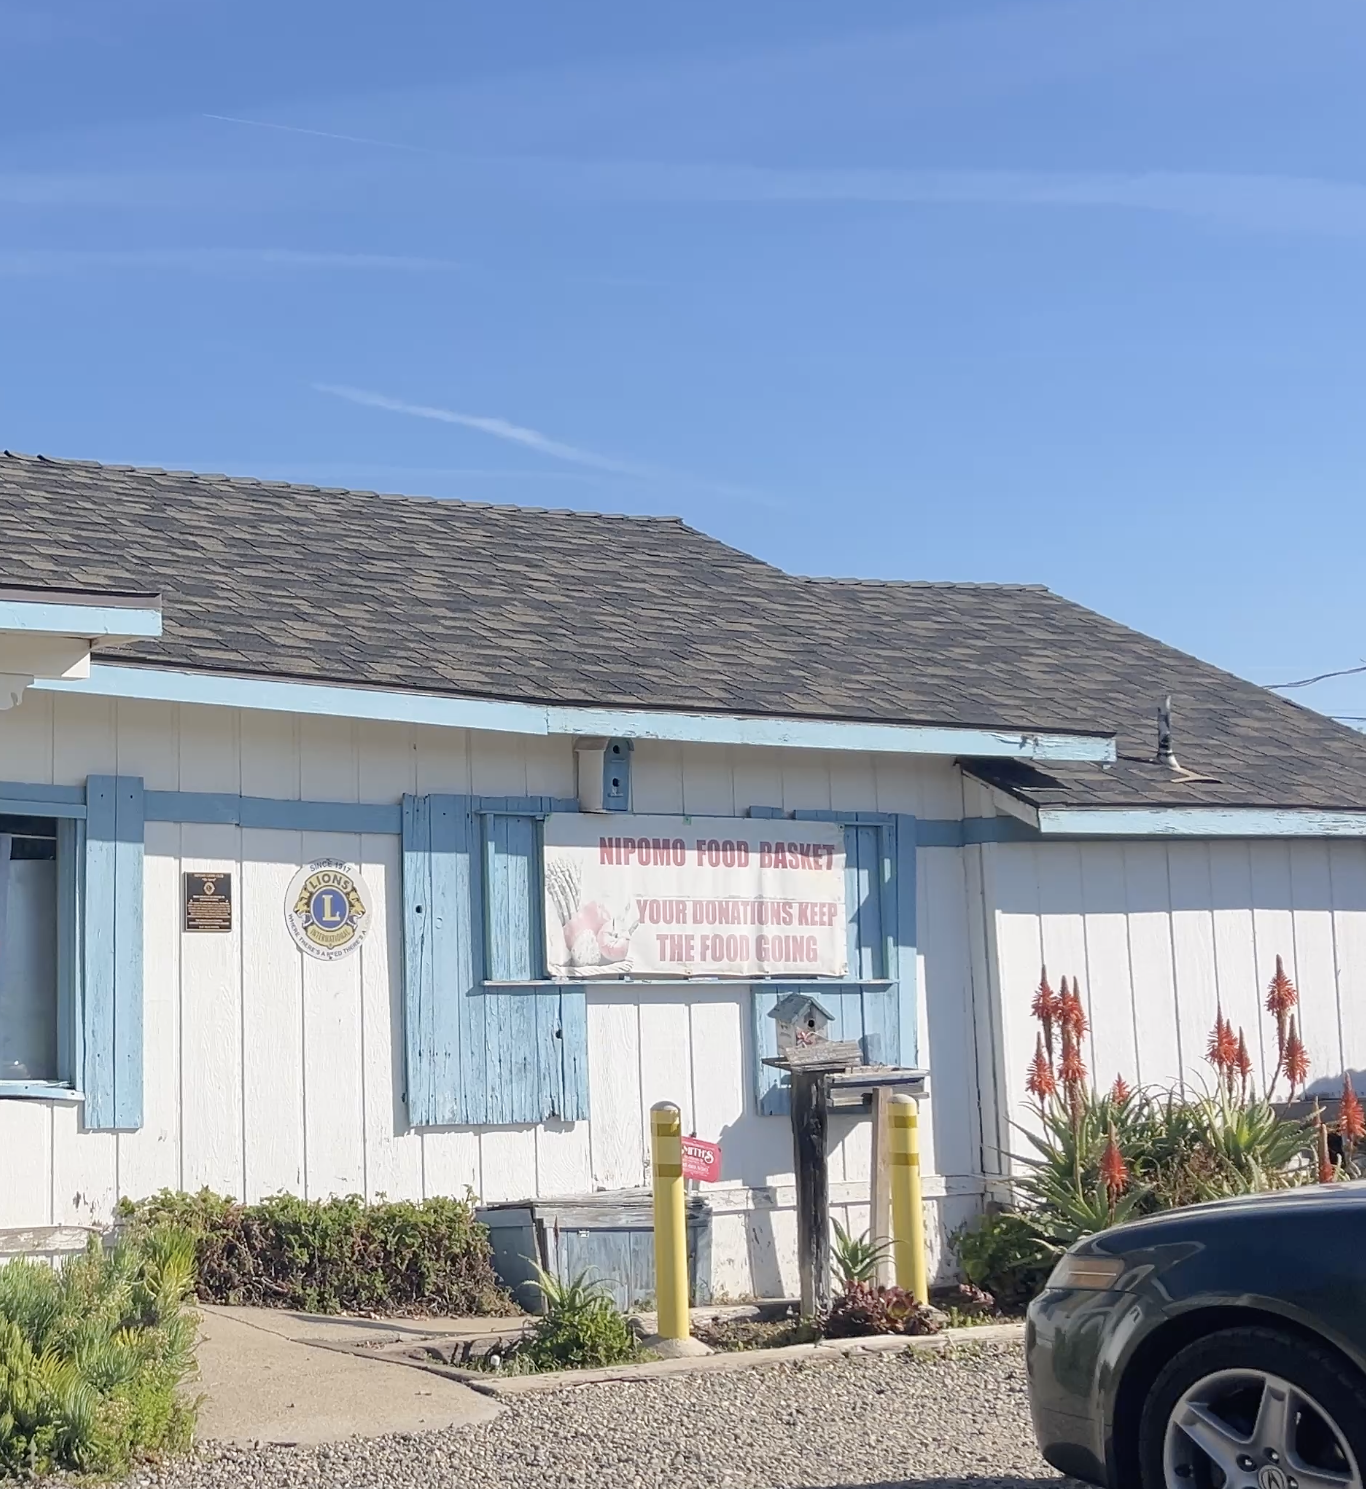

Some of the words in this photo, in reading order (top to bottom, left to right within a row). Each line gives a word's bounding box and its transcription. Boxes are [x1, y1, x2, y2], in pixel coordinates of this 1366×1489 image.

[310, 861, 332, 872] SINCE
[335, 862, 351, 873] 1917
[600, 837, 686, 867] NIPOMO
[696, 839, 750, 868] FOOD
[759, 841, 835, 870] BASKET
[309, 873, 351, 890] LIONS
[322, 894, 341, 921] L
[635, 899, 688, 925] YOUR
[692, 900, 793, 926] DONATIONS
[798, 902, 838, 927] KEEP
[310, 928, 351, 943] INTERNATIONAL
[656, 934, 694, 962] THE
[700, 934, 750, 962] FOOD
[755, 934, 818, 962] GOING
